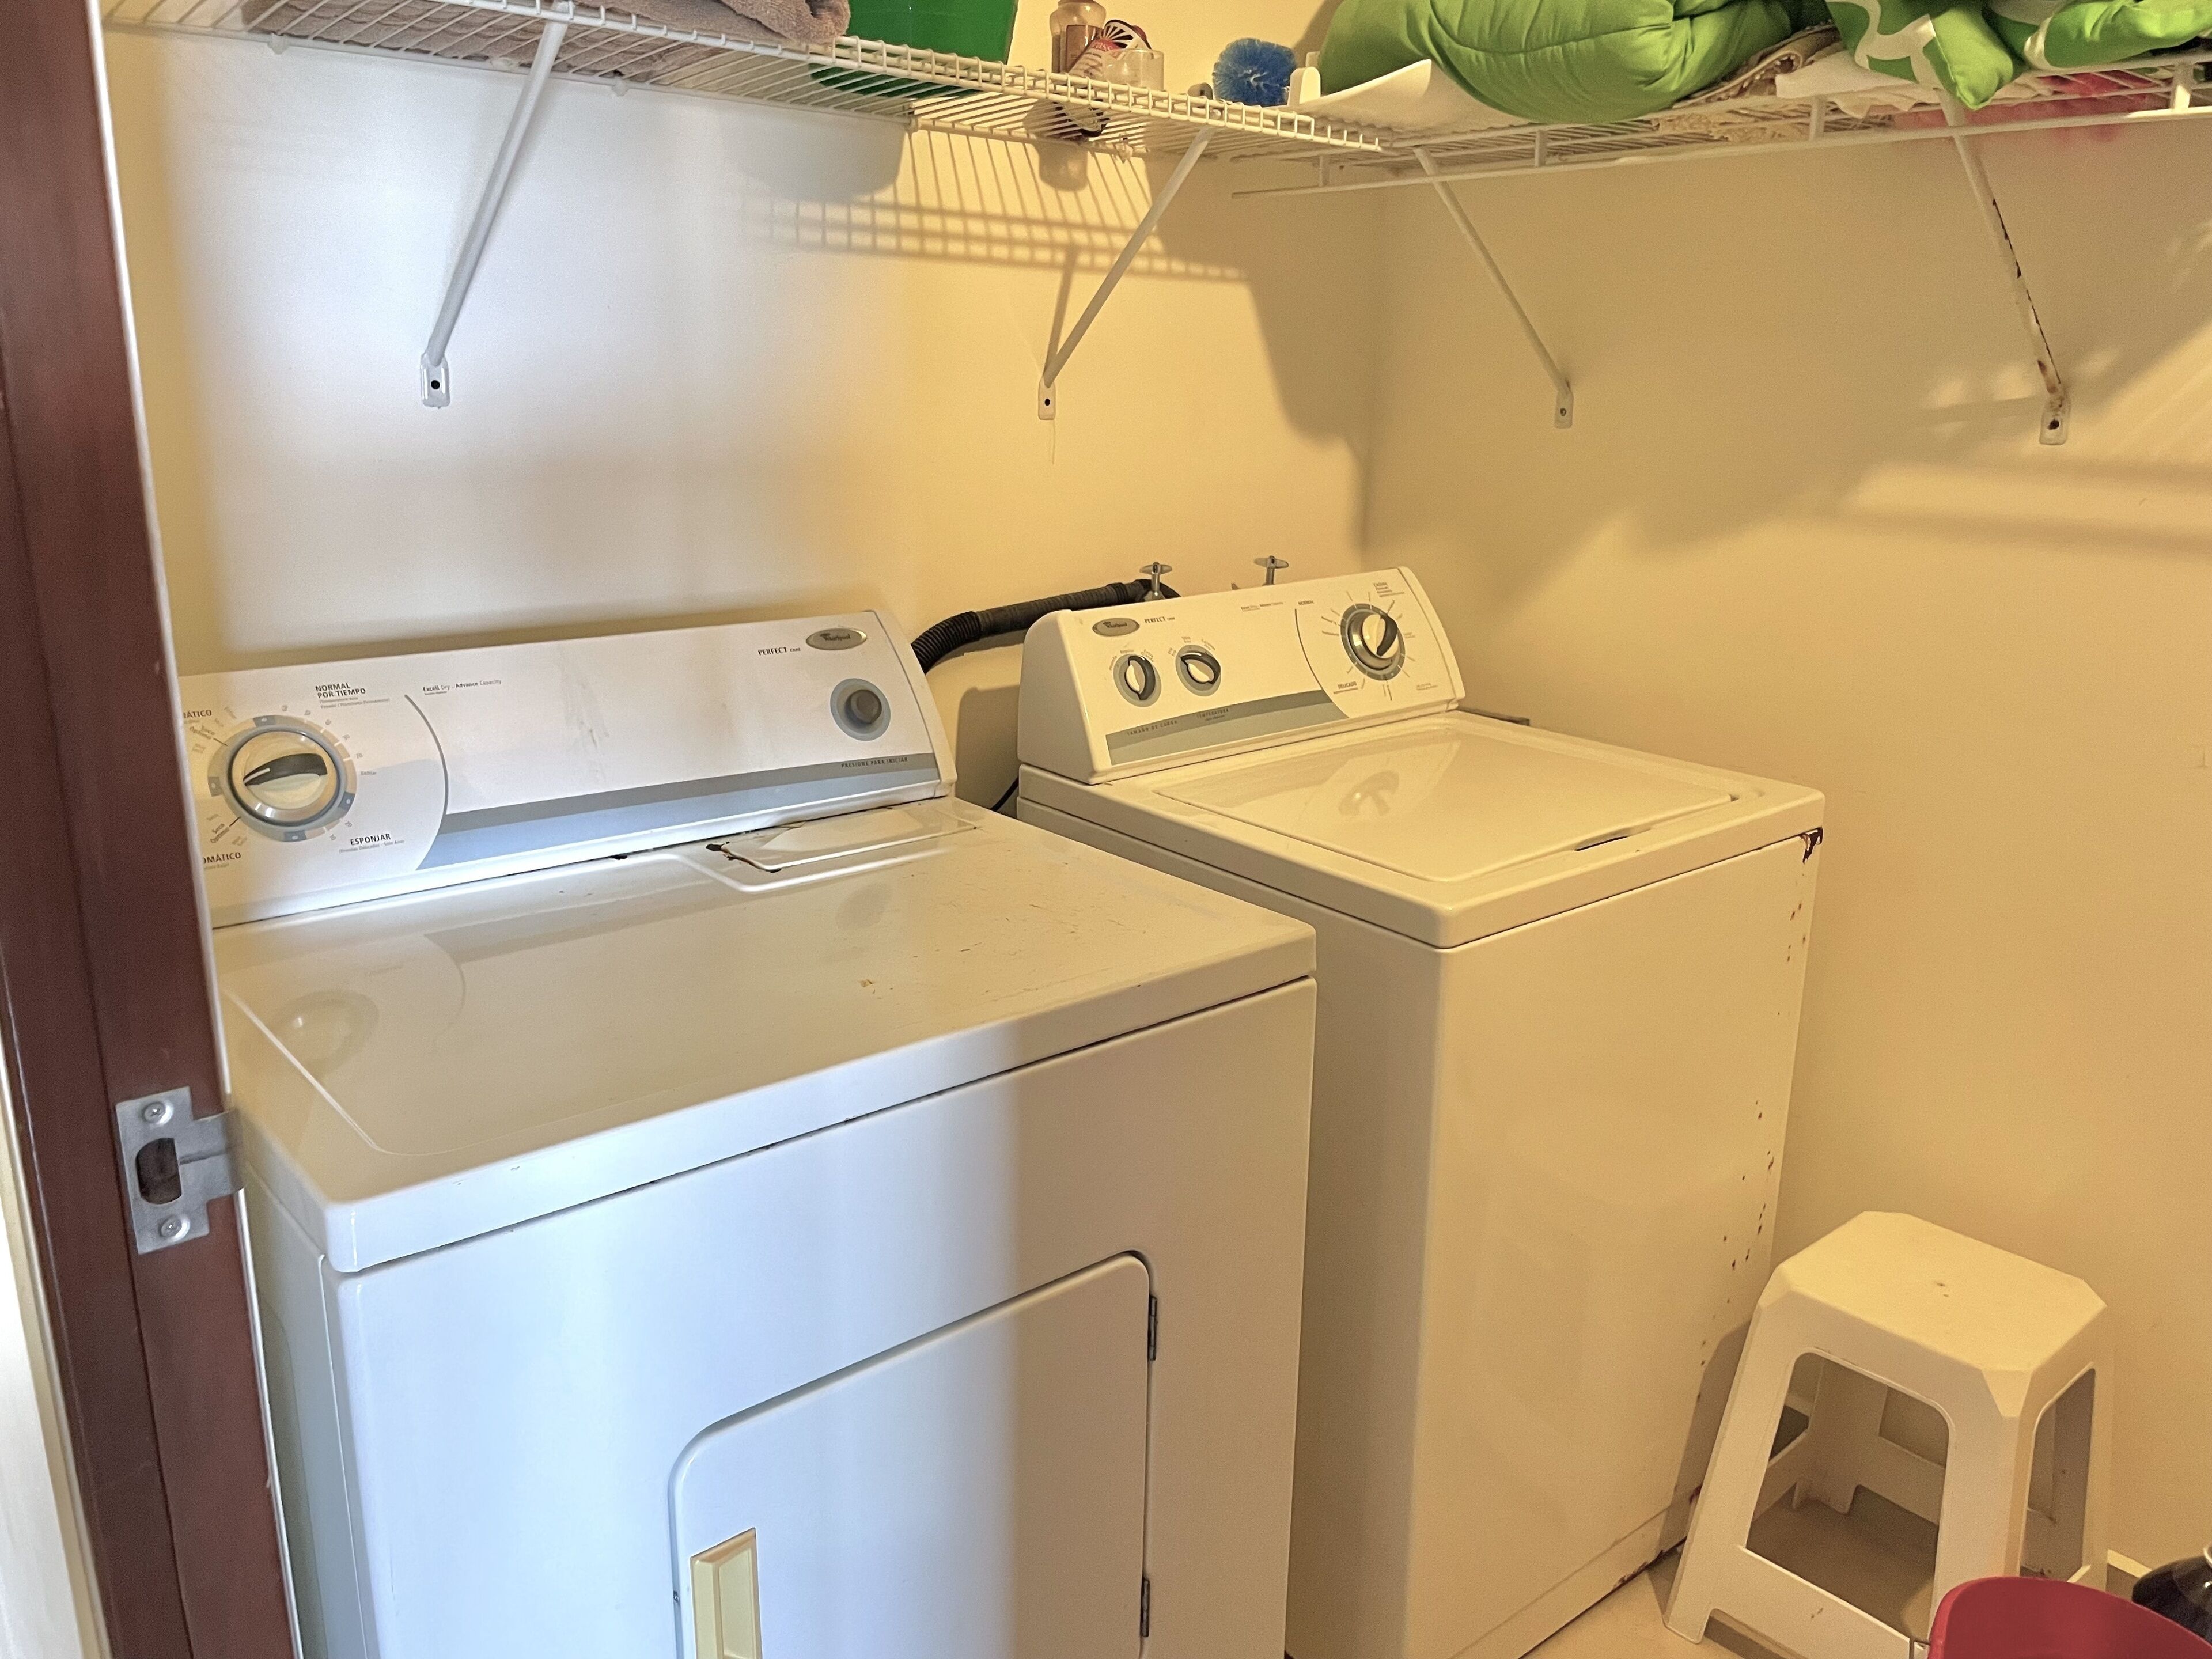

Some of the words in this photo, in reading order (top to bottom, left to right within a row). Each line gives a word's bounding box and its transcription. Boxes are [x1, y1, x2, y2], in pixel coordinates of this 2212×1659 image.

[757, 647, 787, 656] PERFECT
[315, 683, 351, 692] NORMAL
[336, 688, 366, 697] TIEMPO
[350, 833, 391, 846] ESPONJAR
